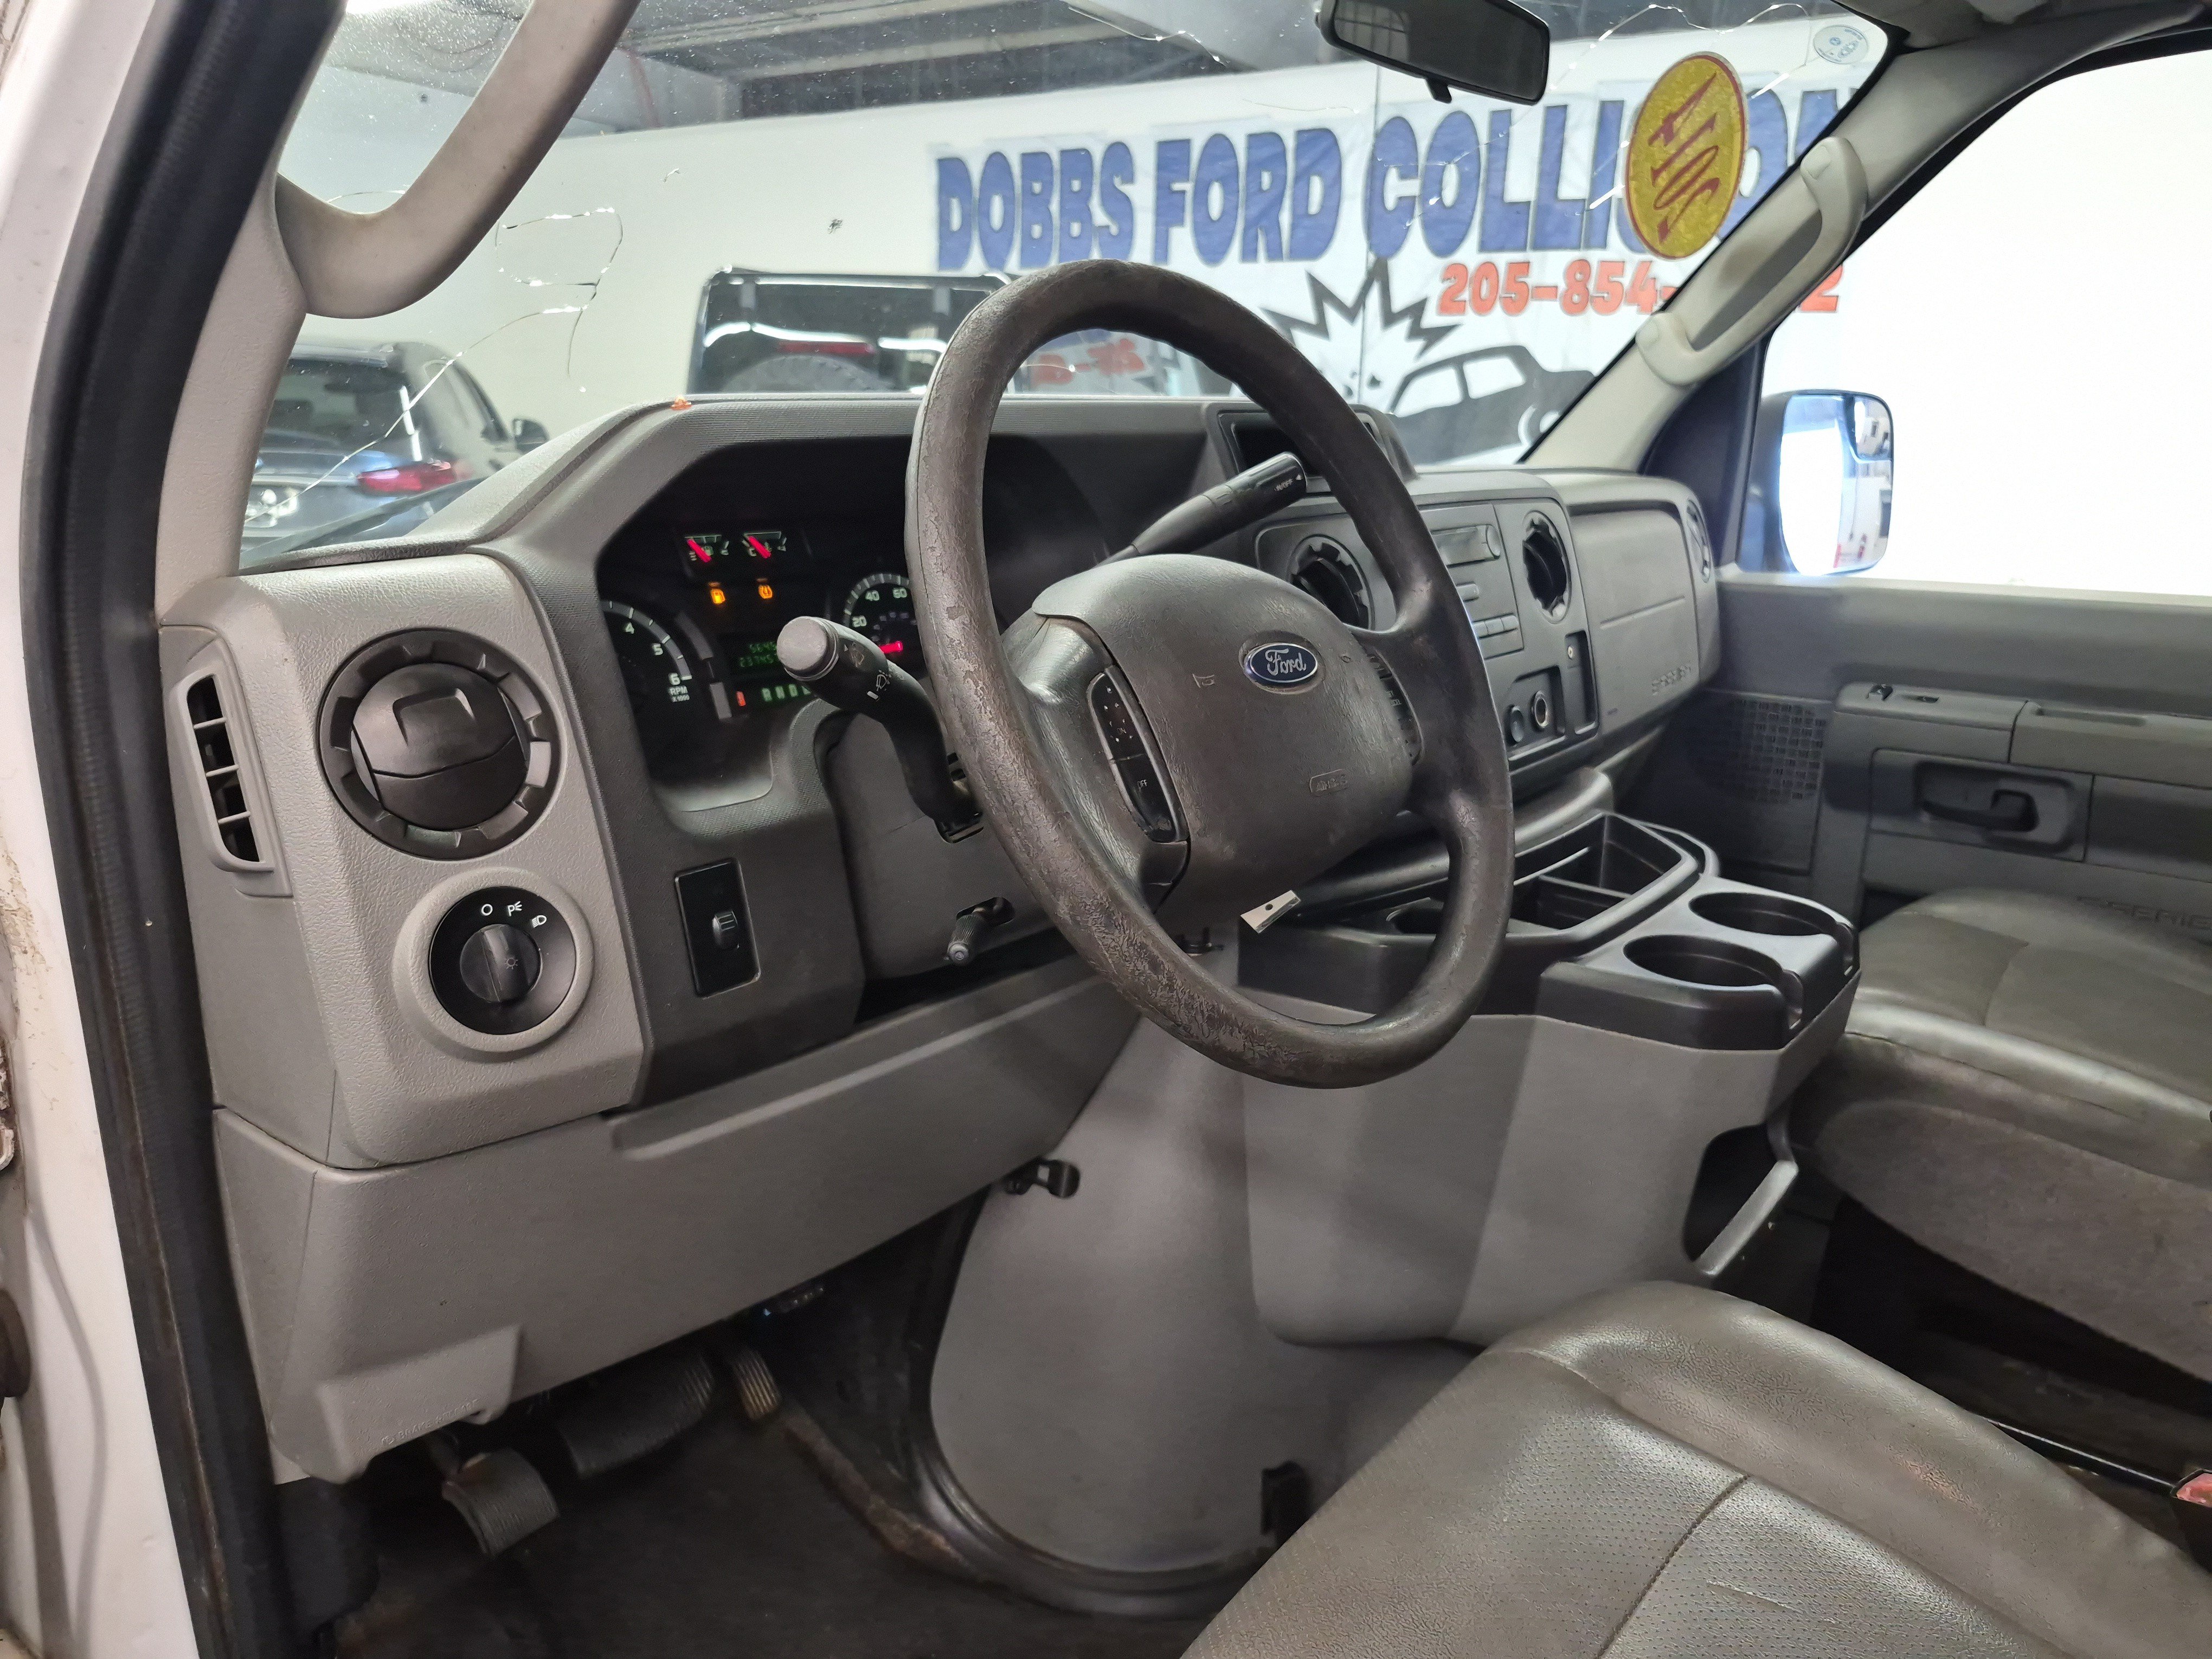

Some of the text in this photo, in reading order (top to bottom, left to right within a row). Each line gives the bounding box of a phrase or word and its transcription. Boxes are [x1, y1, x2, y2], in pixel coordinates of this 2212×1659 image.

[937, 89, 1861, 271] DOBBS FORD COLLI
[1436, 259, 1843, 316] 205-854-2
[852, 615, 866, 627] 20
[625, 622, 635, 634] 4
[652, 643, 664, 655] 5
[1265, 648, 1307, 676] Ford
[668, 672, 680, 685] 6
[668, 686, 689, 696] RPM
